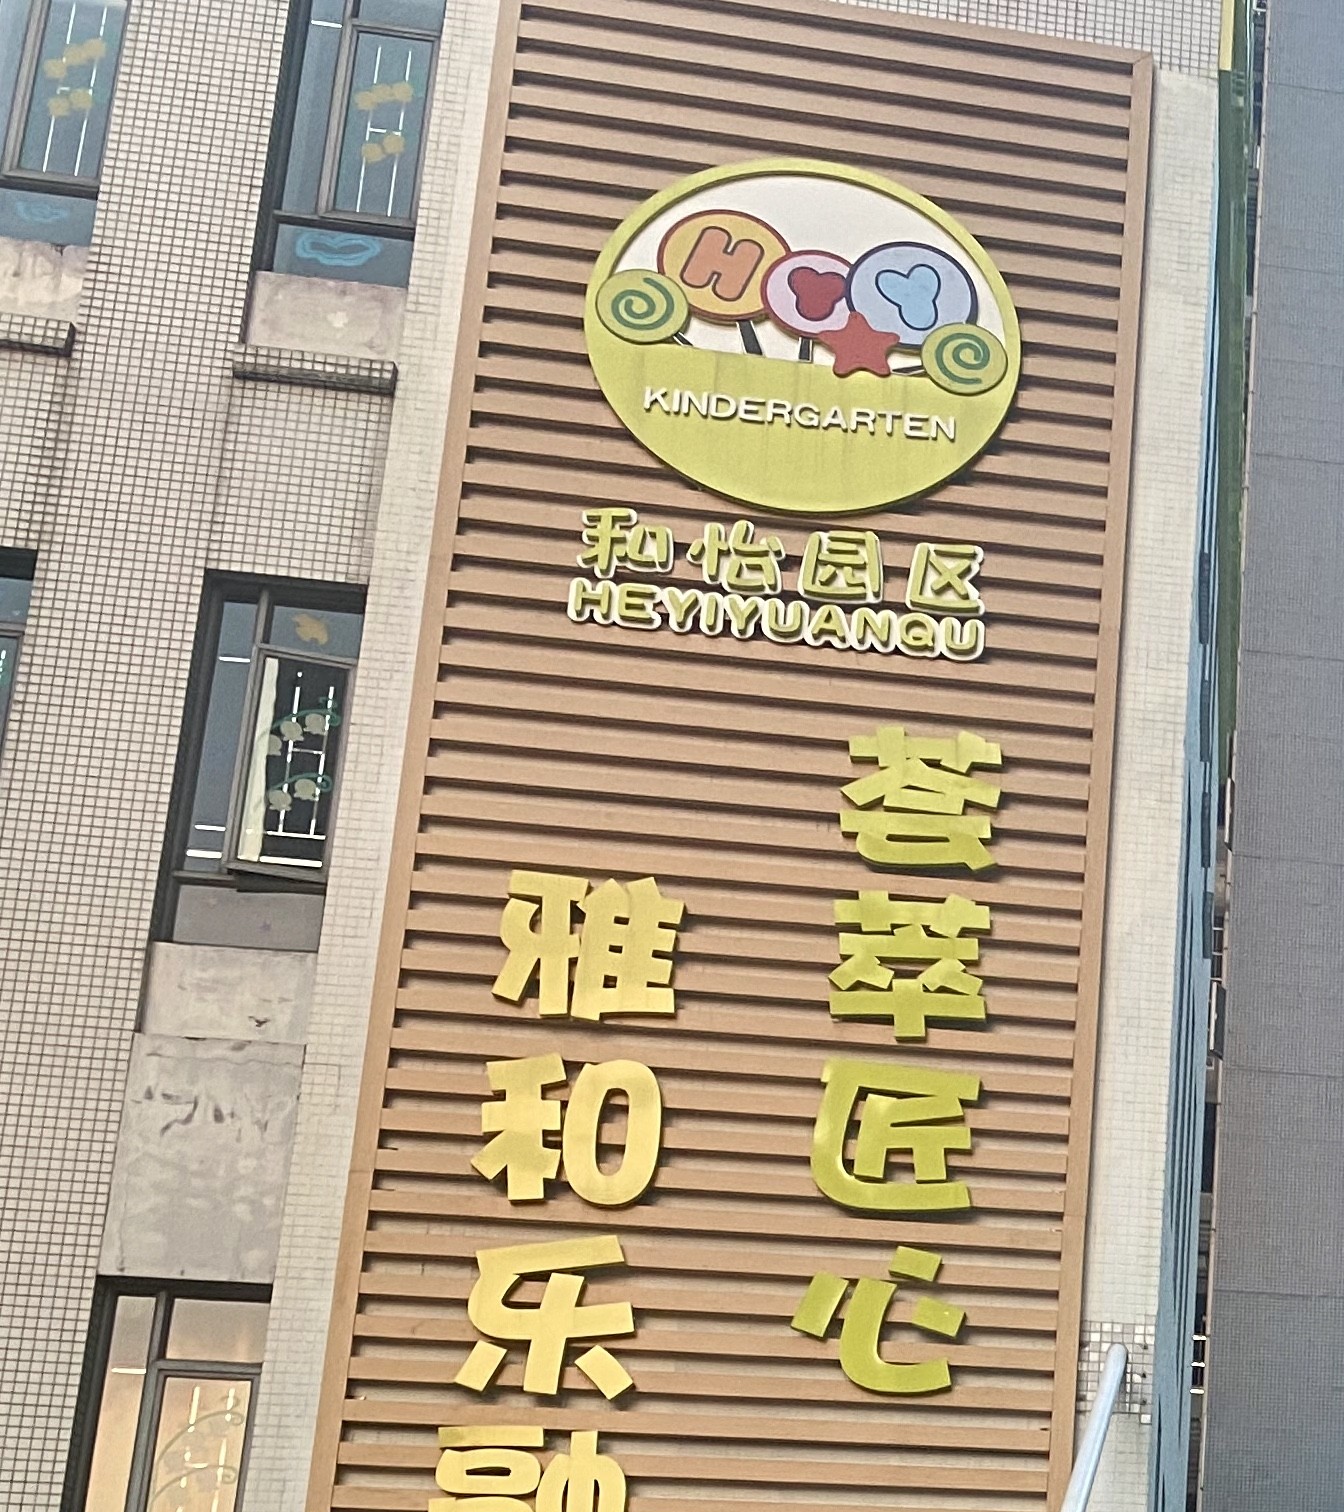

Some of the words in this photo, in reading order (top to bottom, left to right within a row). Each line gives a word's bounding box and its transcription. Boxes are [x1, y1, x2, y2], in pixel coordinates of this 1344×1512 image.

[642, 385, 957, 441] KINDERGARTEN
[577, 507, 986, 615] 和怡园区
[567, 578, 985, 662] HEYIYUANQU
[792, 726, 1003, 1395] 荟萃匠心
